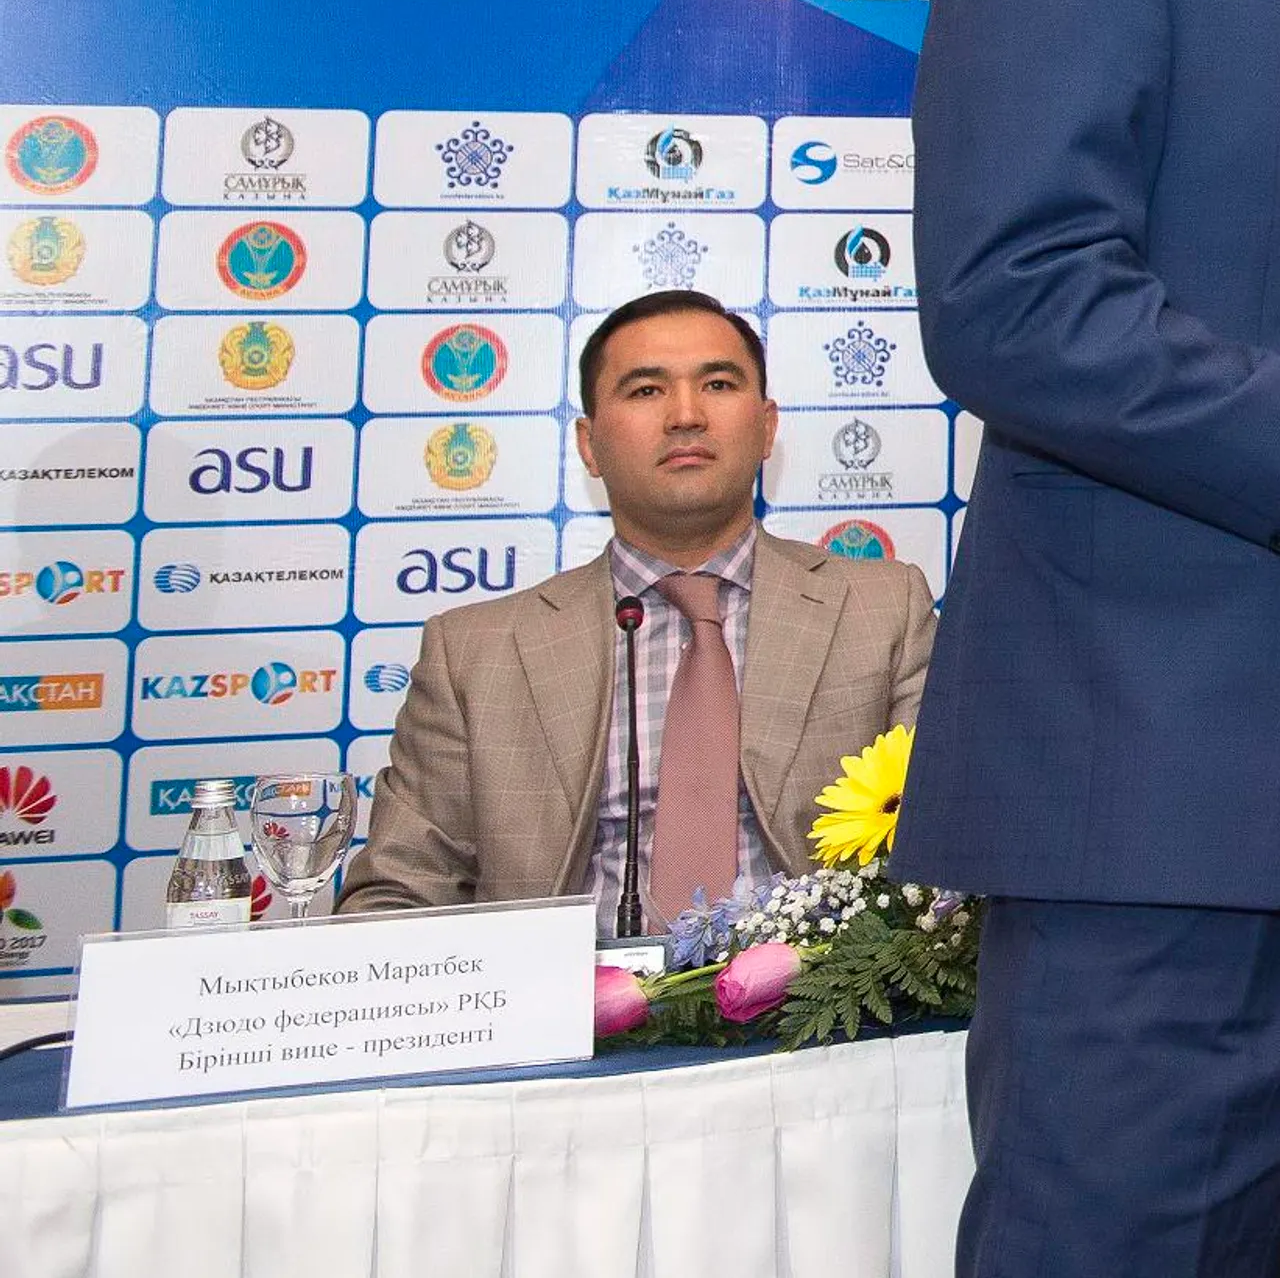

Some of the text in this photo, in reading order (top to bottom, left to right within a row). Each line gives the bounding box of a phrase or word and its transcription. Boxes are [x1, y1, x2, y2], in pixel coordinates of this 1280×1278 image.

[188, 446, 314, 495] asu
[210, 568, 344, 584] ҚАЗАҚТЕЛЕКОМ
[397, 544, 517, 596] asu
[200, 955, 484, 997] Мықтыбеков Маратбек
[169, 989, 507, 1039] «Дзюдо федерациясы» РҚБ
[179, 1043, 273, 1073] Бірінші
[281, 1043, 339, 1062] вице
[364, 1022, 494, 1056] президенті
